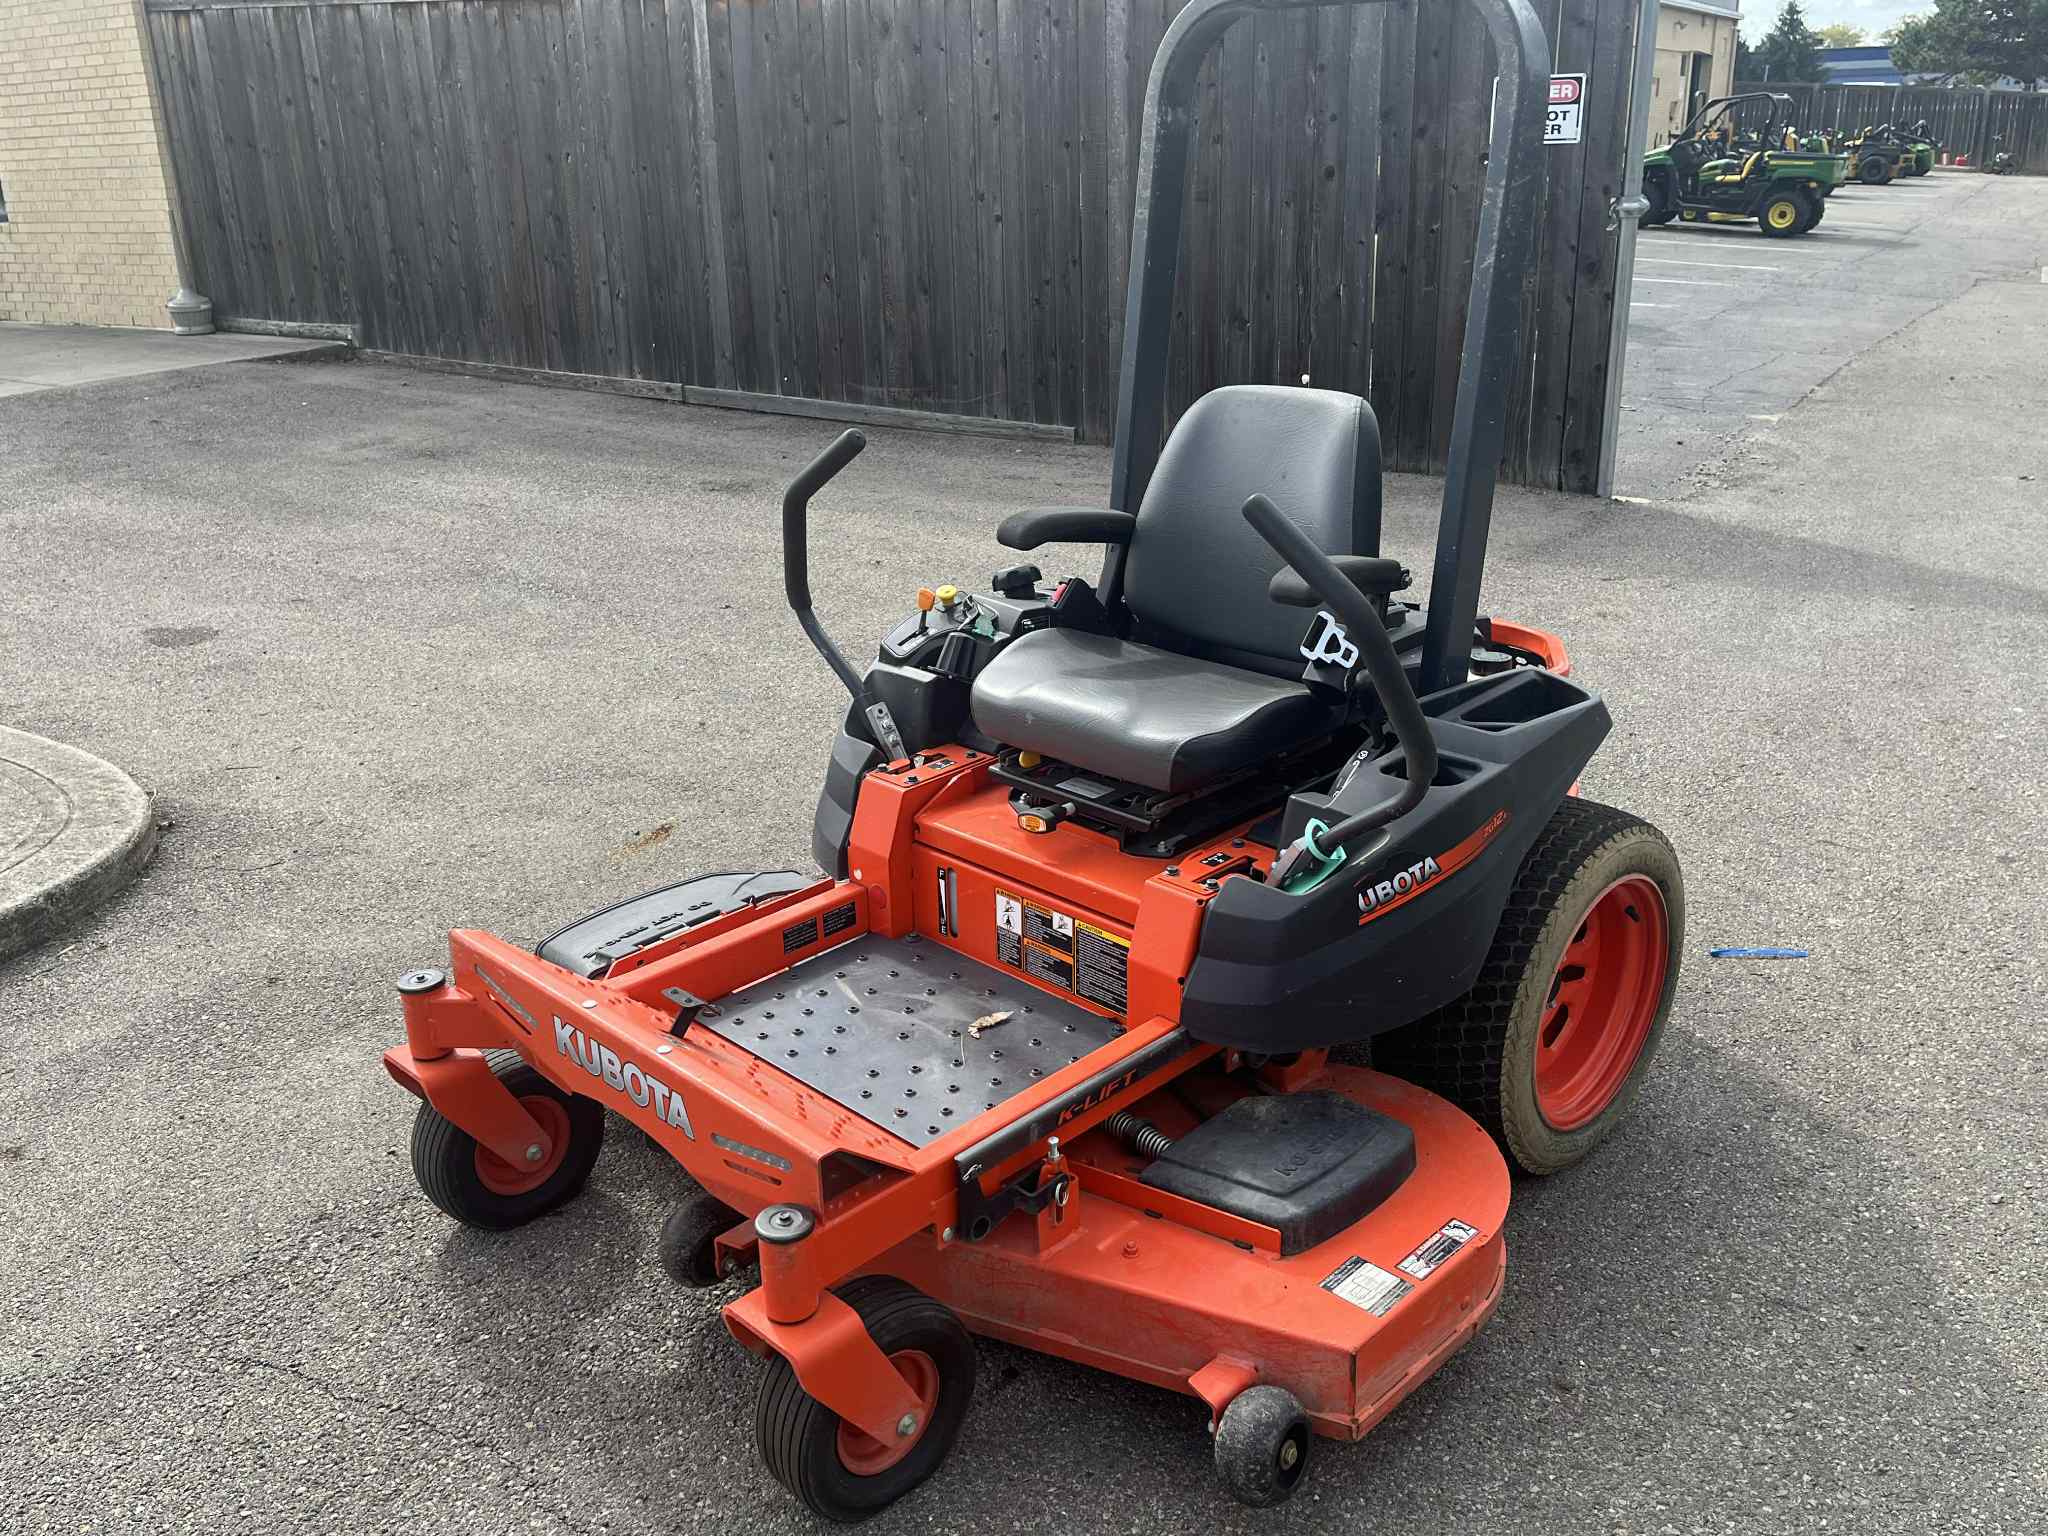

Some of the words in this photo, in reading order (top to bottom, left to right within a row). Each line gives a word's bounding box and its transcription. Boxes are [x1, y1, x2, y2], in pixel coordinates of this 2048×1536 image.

[1550, 84, 1573, 98] ER
[1544, 124, 1562, 135] ER
[1547, 110, 1570, 121] OT
[1358, 856, 1441, 912] UBOTA
[553, 1015, 695, 1141] KUBOTA
[1058, 1068, 1136, 1126] K-LIFT
